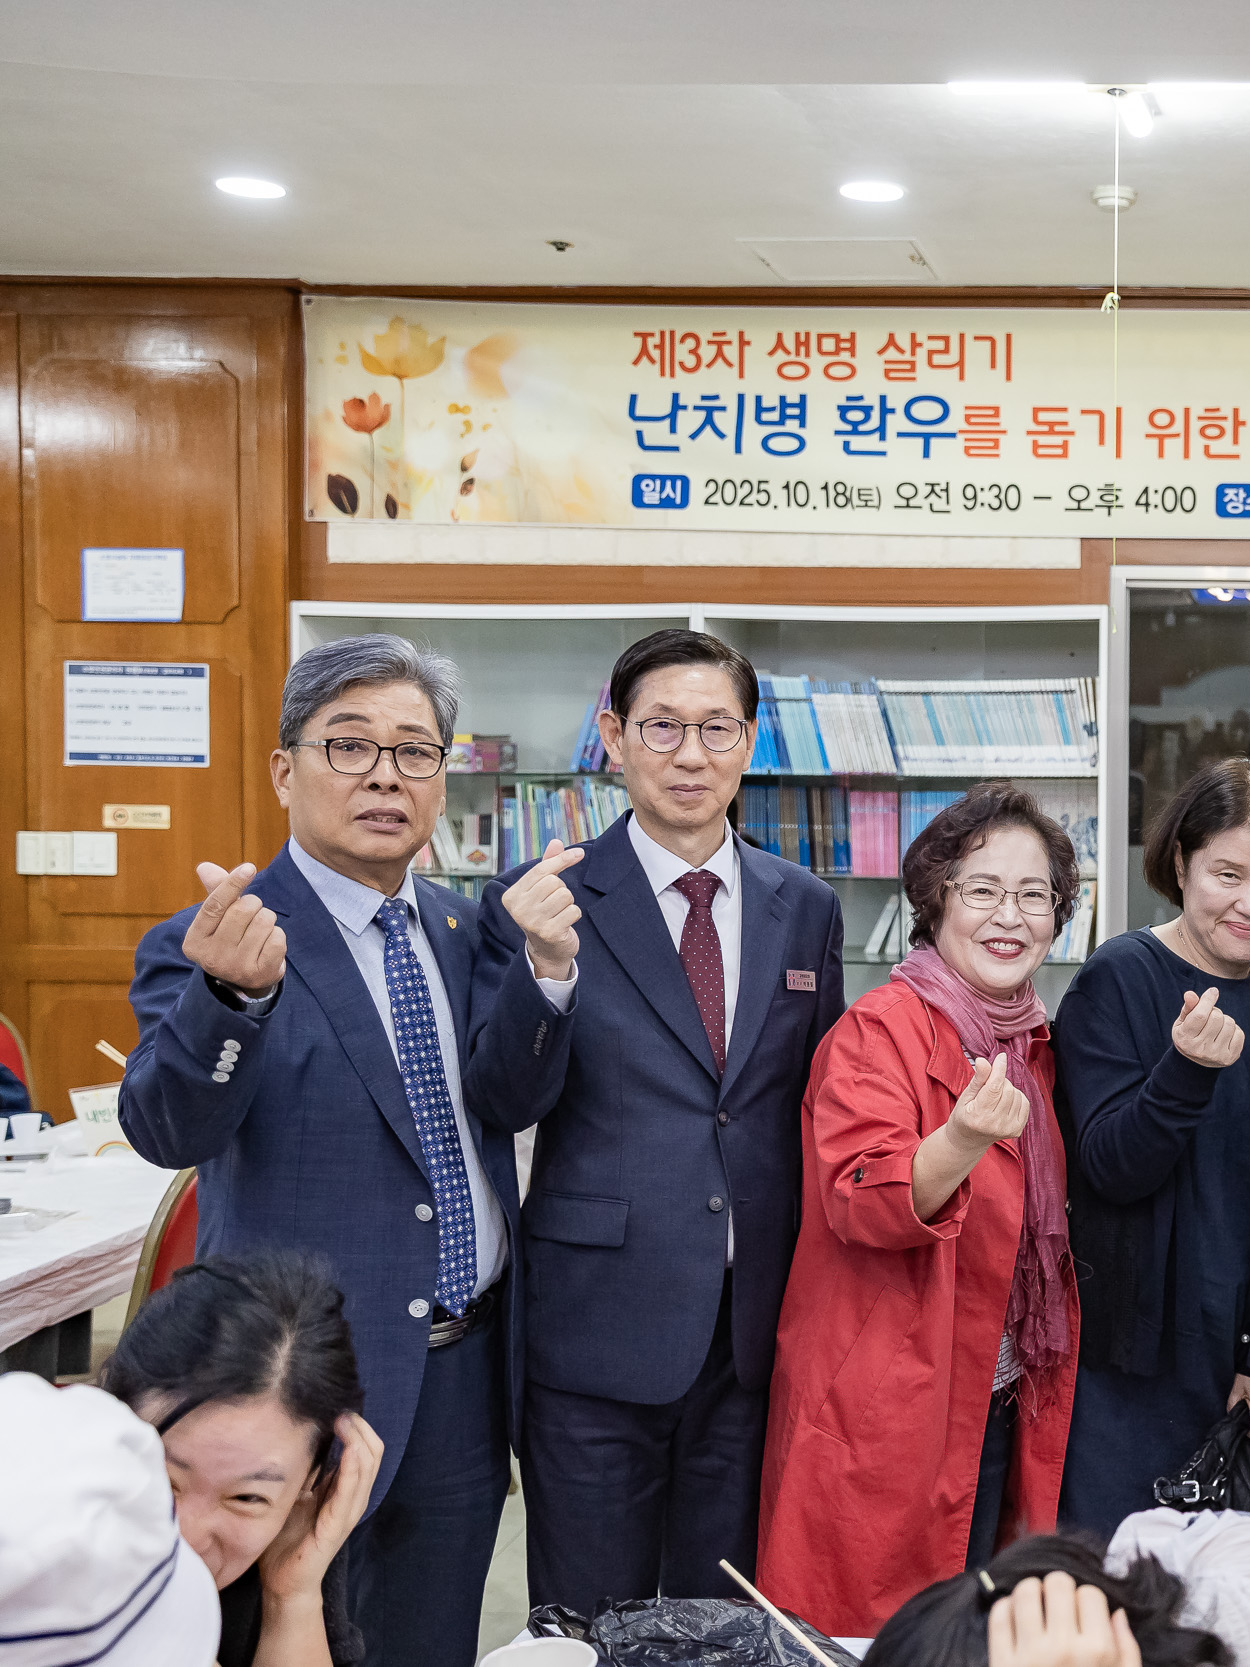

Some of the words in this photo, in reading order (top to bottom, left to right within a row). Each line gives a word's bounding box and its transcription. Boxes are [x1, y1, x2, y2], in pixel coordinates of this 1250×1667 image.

[632, 330, 752, 379] 제3차
[768, 332, 857, 381] 생명
[877, 333, 1013, 382] 살리기
[628, 392, 808, 457] 난치병
[834, 395, 1008, 459] 환우를
[1026, 407, 1122, 459] 돕기
[1146, 408, 1247, 460] 위한
[640, 479, 682, 504] 일시
[704, 479, 882, 511] 2025.10.18(토)
[894, 482, 952, 514] 오전
[963, 484, 1022, 512] 9:30
[1065, 484, 1125, 518] 오후
[1135, 485, 1197, 515] 4:00
